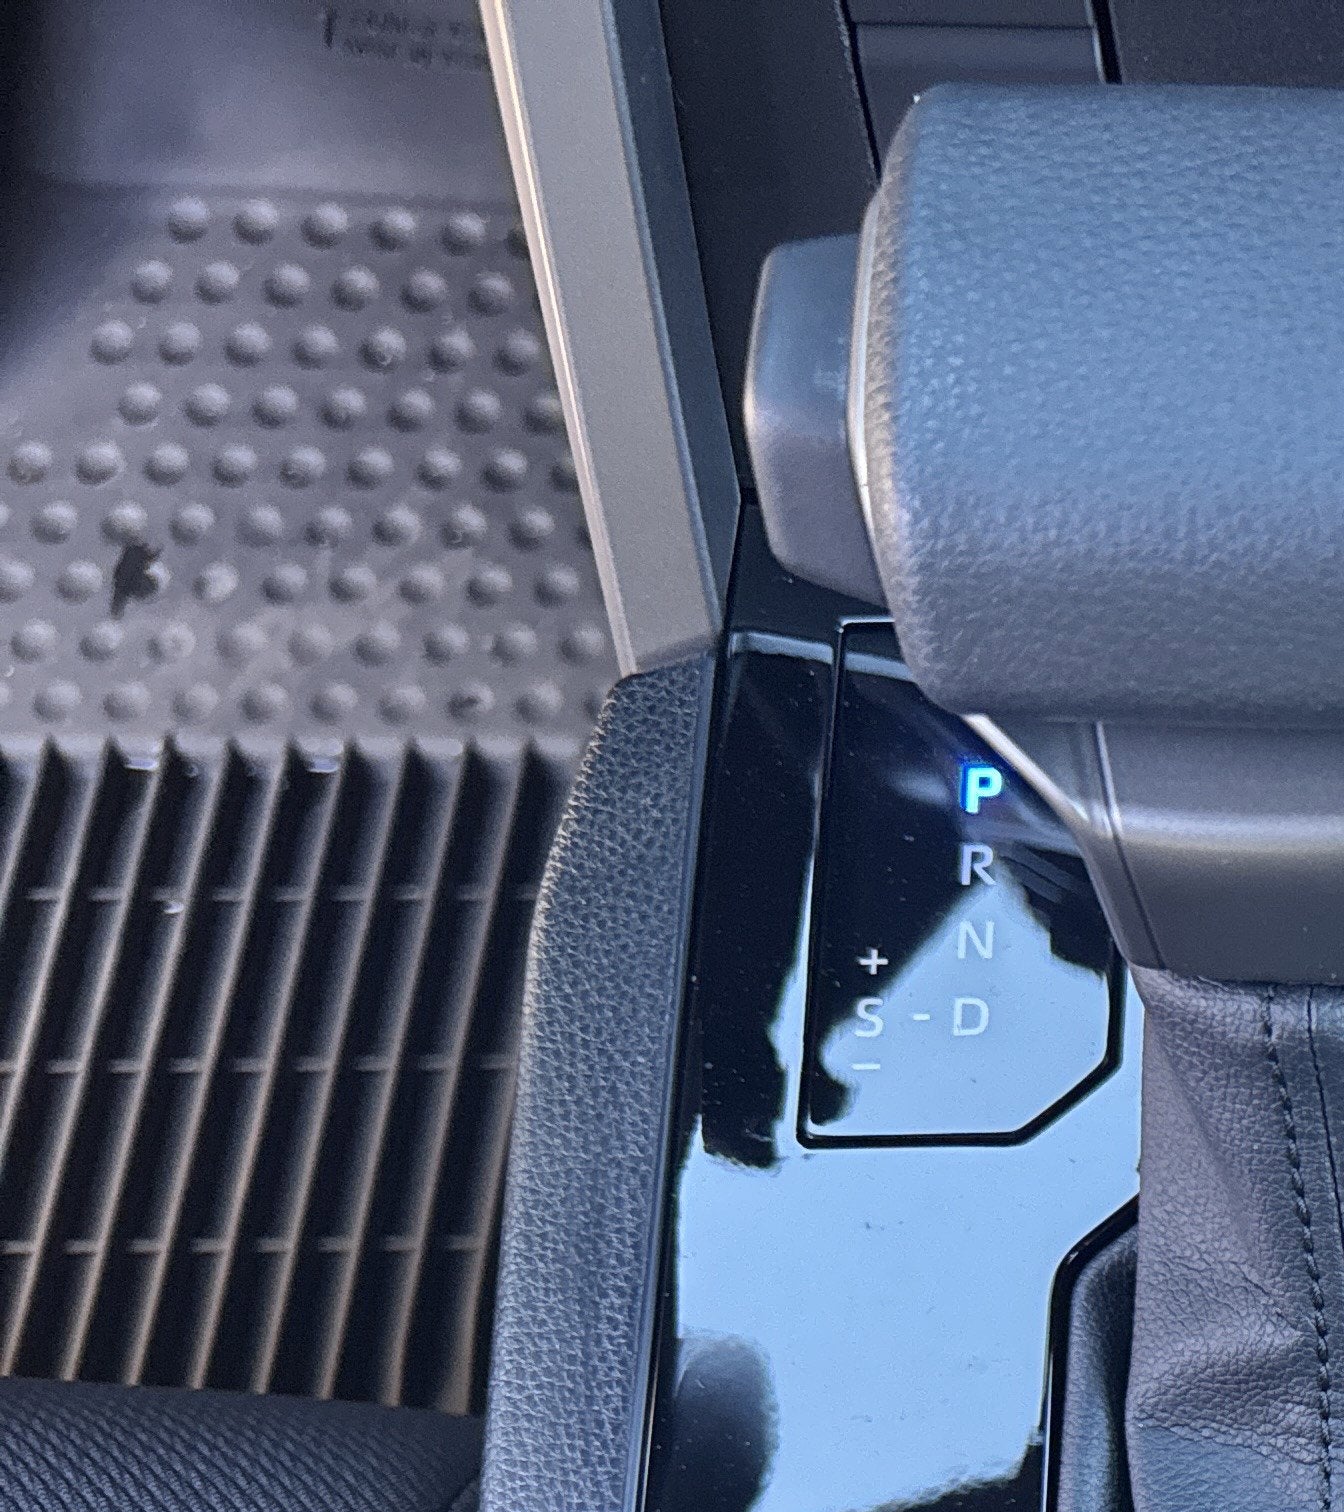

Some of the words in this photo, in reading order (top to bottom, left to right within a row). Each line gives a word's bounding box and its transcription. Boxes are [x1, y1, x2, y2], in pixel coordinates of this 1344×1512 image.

[961, 765, 1001, 814] P
[961, 845, 995, 885] R
[957, 920, 993, 960] N
[854, 998, 884, 1038] S
[953, 998, 990, 1037] D
